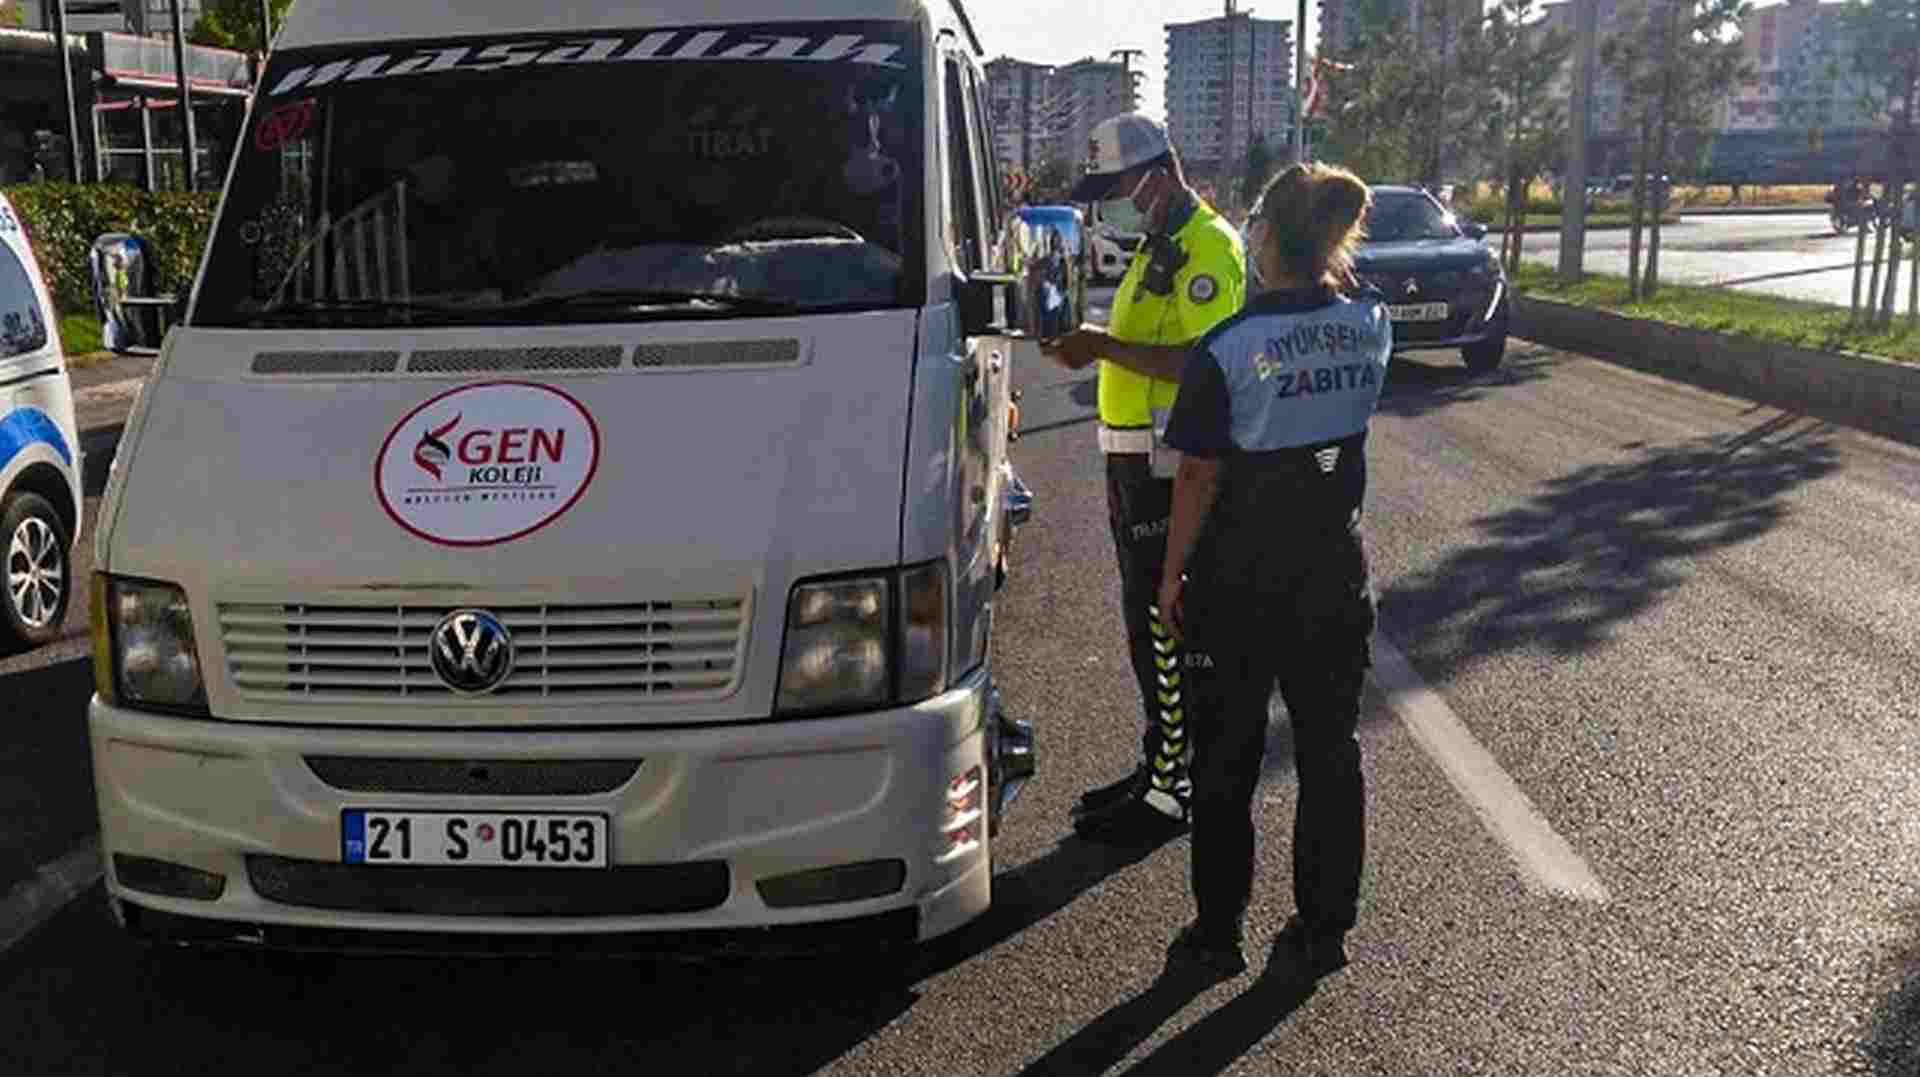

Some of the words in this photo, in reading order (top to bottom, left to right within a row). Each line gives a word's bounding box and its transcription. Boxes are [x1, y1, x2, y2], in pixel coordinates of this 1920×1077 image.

[1276, 362, 1379, 400] ZABITA
[457, 427, 566, 465] GEN
[368, 817, 412, 860] 21
[445, 817, 469, 861] S
[500, 818, 596, 862] 0453
